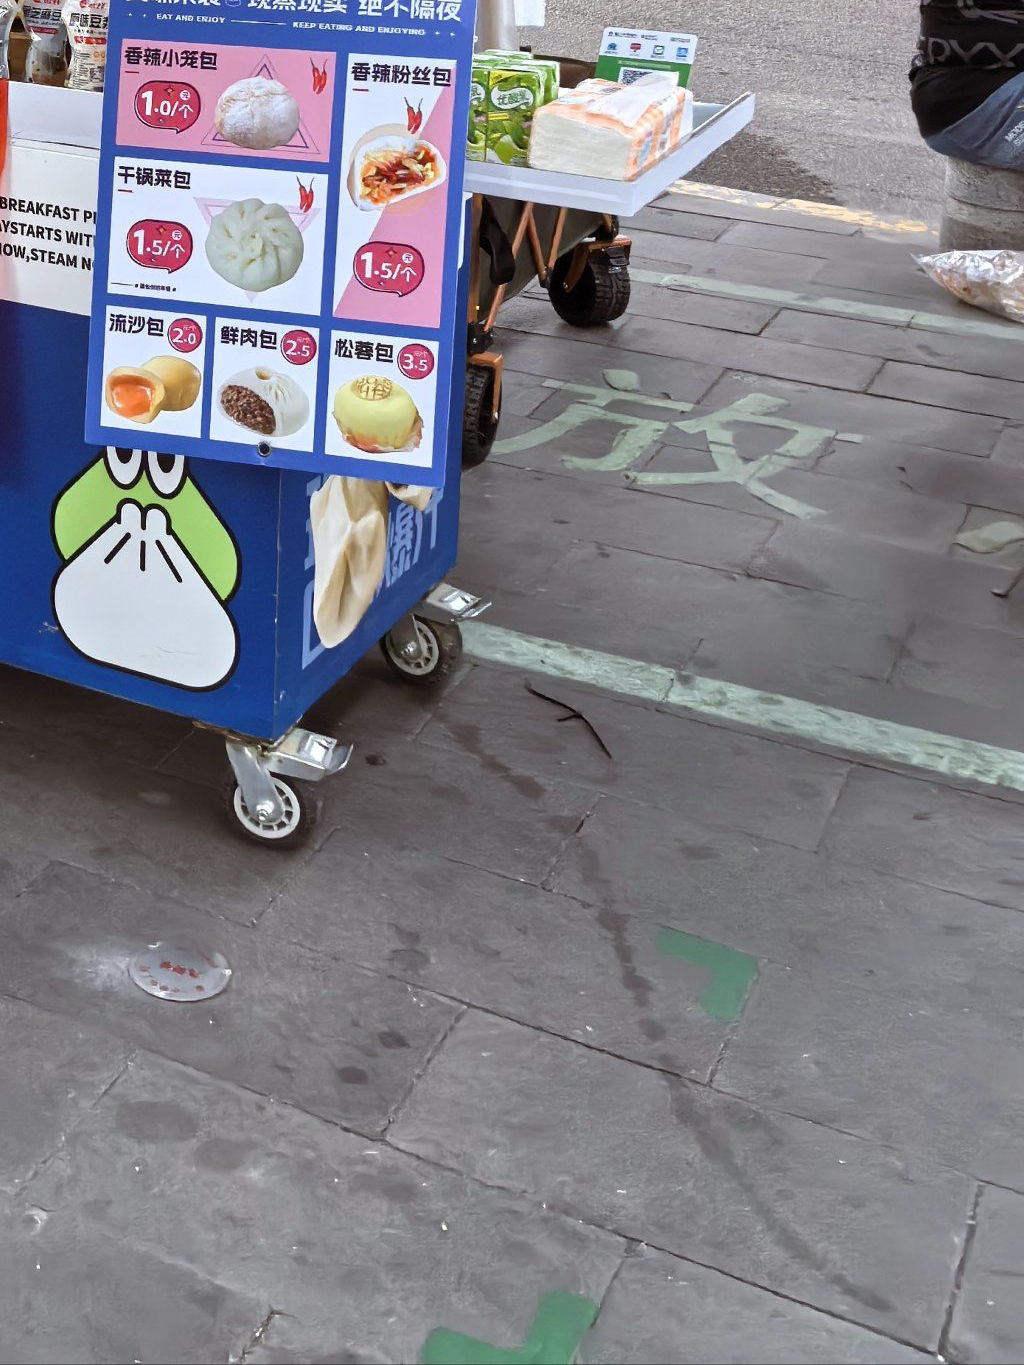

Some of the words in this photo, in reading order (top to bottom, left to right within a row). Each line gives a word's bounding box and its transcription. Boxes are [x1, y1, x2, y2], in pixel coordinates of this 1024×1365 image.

[156, 12, 173, 21] EAT
[176, 14, 195, 22] AND
[197, 15, 225, 25] ENJOY
[292, 20, 316, 30] KEEP
[318, 22, 353, 31] EATING
[355, 24, 375, 33] AND
[124, 46, 218, 71] 香辣小笼包
[351, 62, 451, 88] 香辣粉丝包
[117, 165, 192, 190] 干锅菜包
[65, 230, 95, 248] WIT
[109, 313, 165, 337] 流沙包
[171, 328, 197, 346] 2.0
[220, 326, 277, 351] 鲜肉包
[285, 339, 311, 358] 2.5
[334, 338, 394, 363] 松蓉包
[402, 354, 428, 373] 3.5
